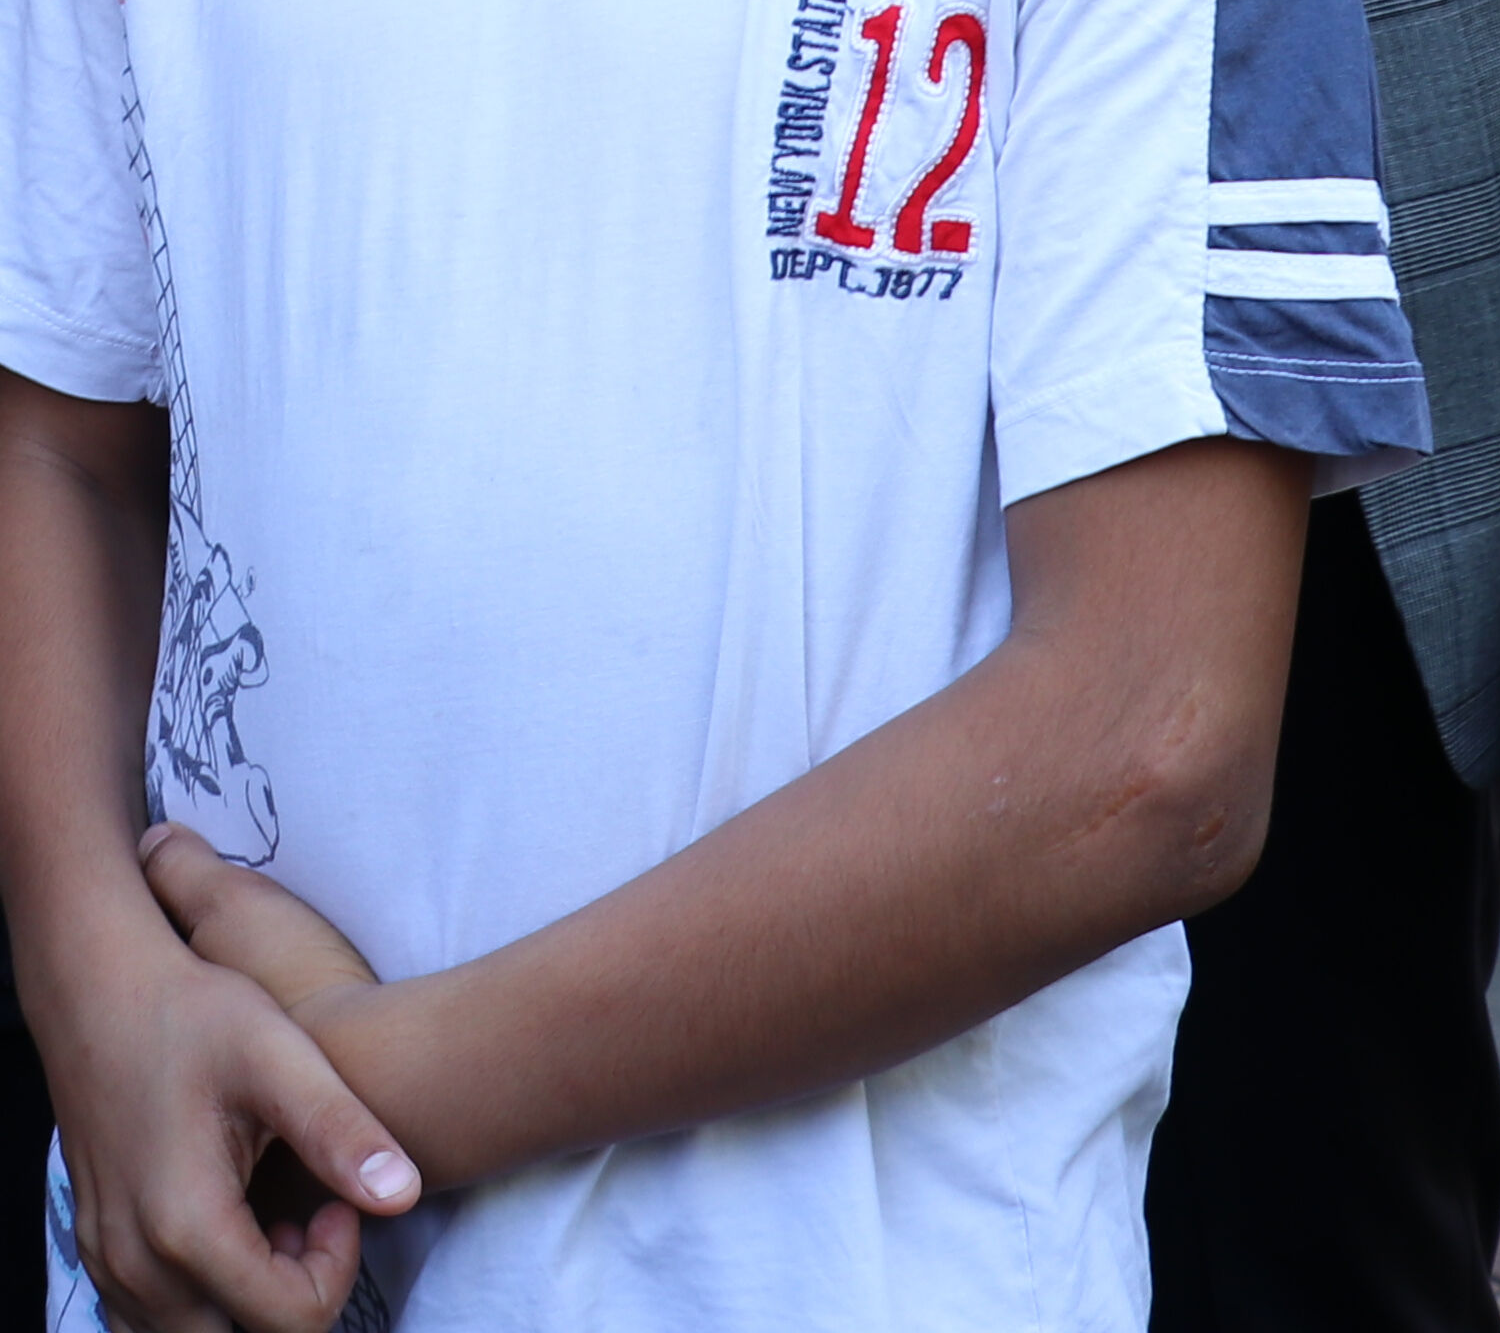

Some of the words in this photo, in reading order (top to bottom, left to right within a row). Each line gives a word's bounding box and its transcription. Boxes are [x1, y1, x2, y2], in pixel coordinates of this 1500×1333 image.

[772, 79, 831, 159] YORK
[814, 4, 987, 255] 12
[766, 170, 816, 237] NEW
